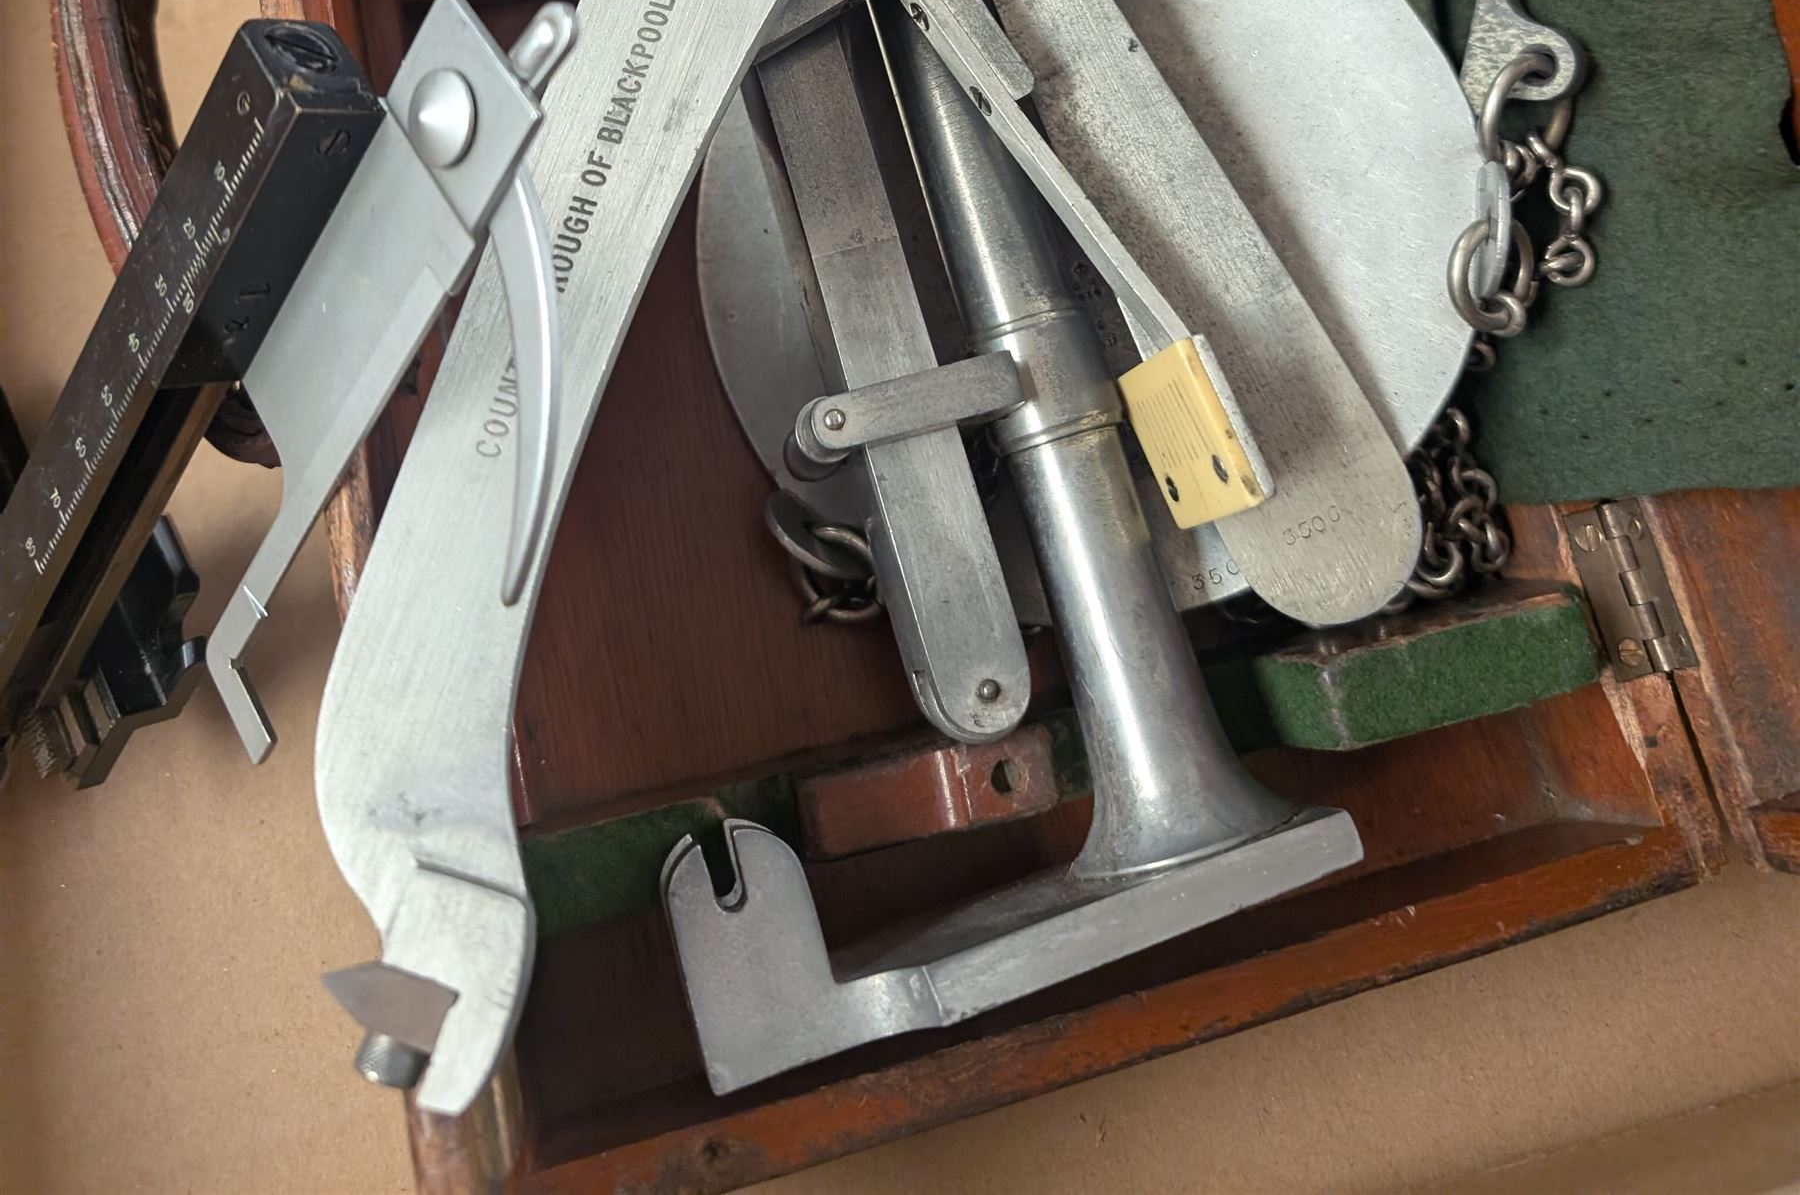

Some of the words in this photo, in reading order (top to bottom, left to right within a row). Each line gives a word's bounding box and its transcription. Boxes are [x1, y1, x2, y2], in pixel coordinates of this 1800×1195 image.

[580, 149, 613, 187] OF
[74, 436, 87, 458] 60
[49, 486, 62, 509] 70
[1282, 505, 1341, 546] 3500
